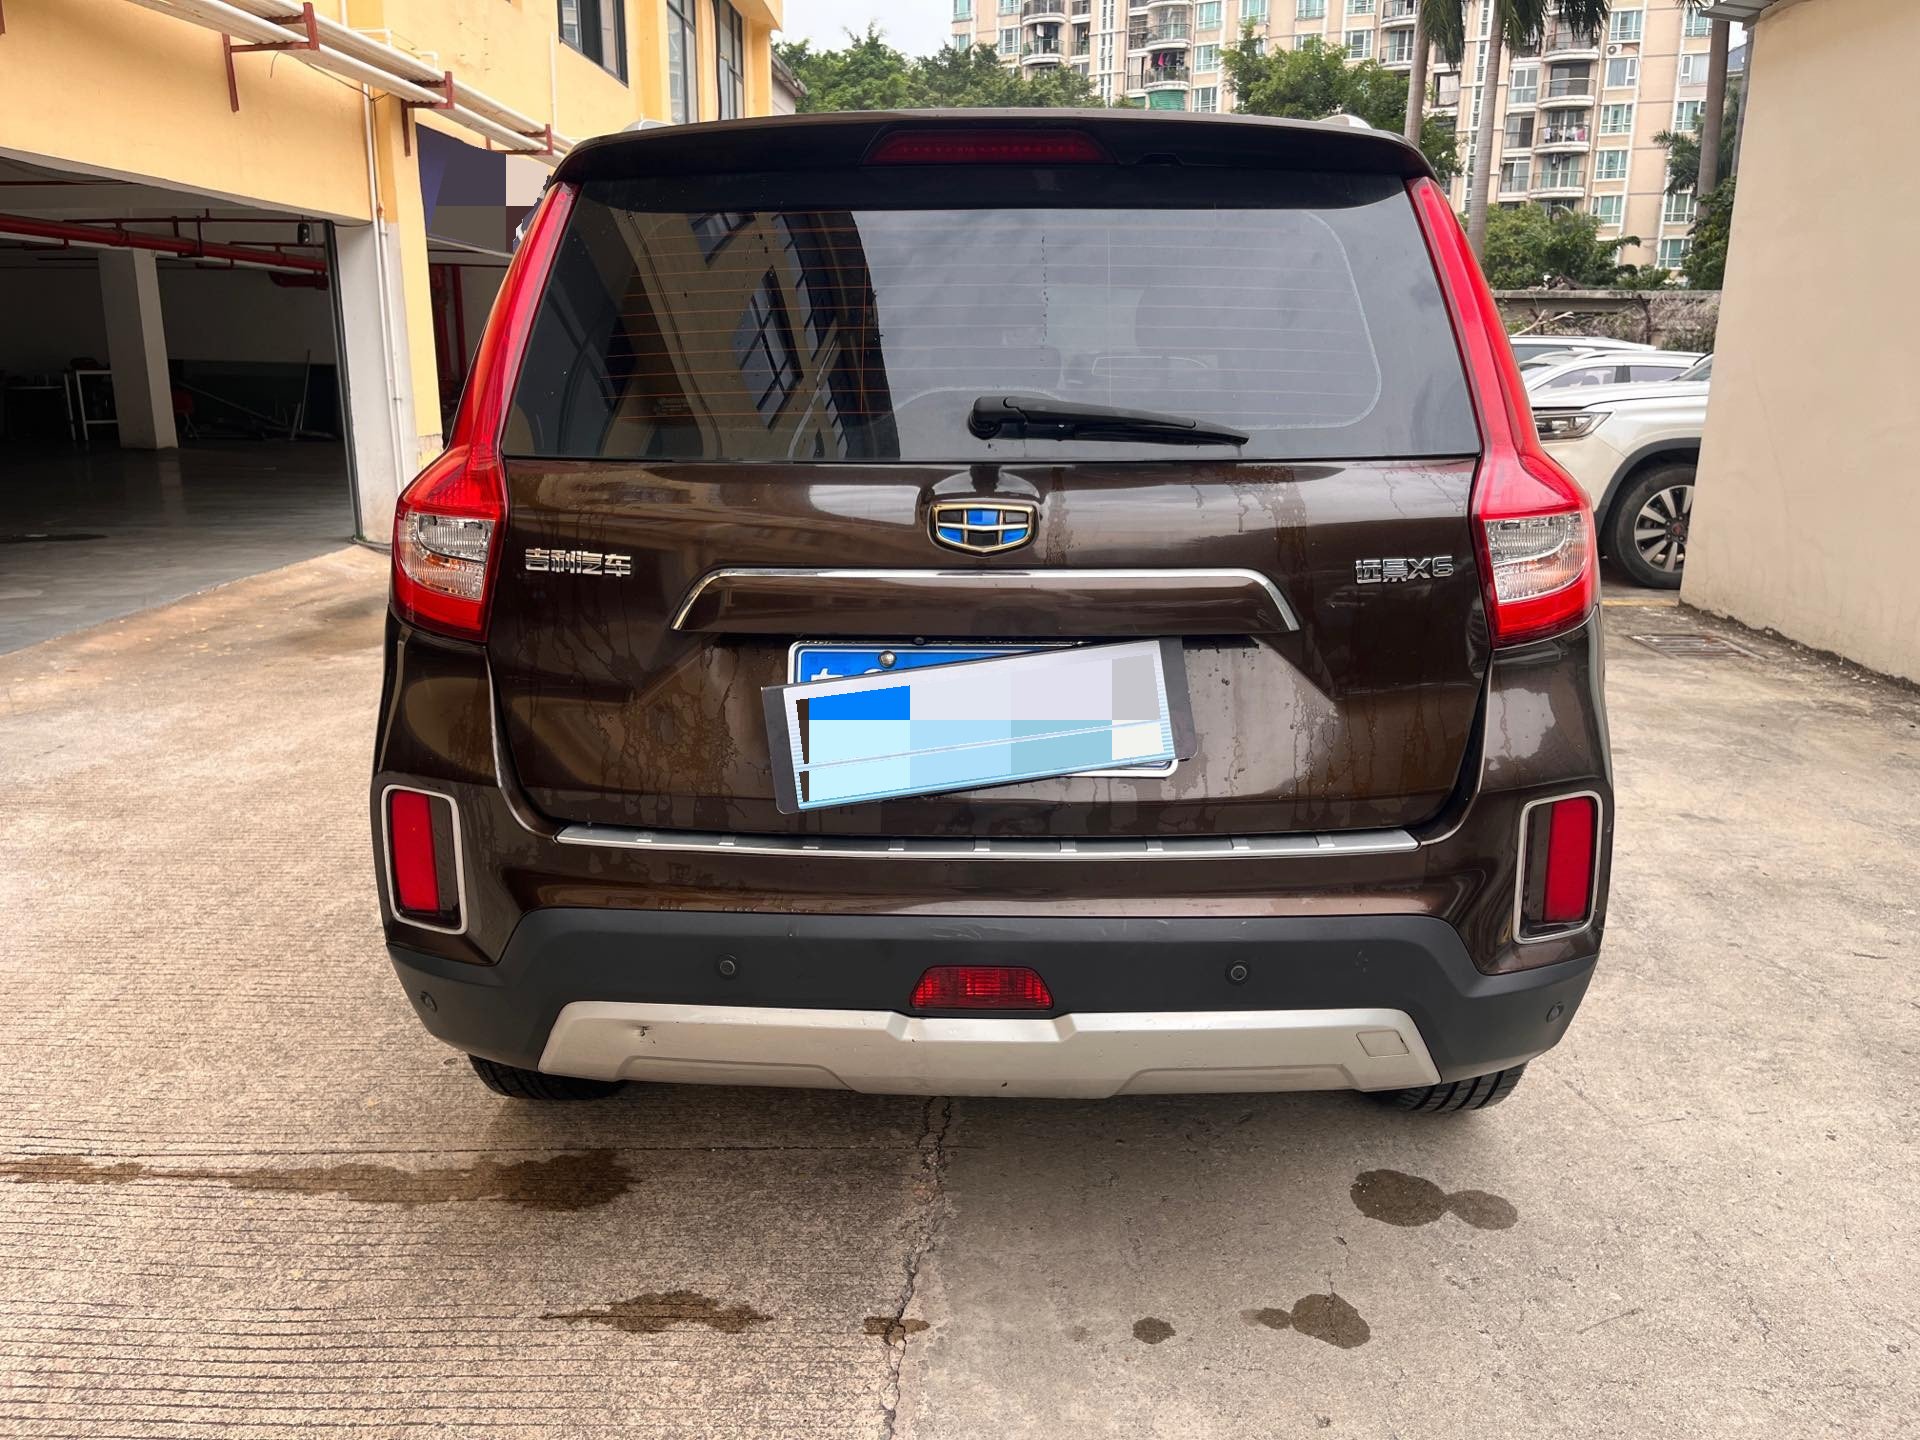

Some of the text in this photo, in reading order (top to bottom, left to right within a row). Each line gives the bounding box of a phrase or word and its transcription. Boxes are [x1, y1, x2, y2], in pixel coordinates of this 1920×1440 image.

[525, 548, 631, 577] 吉利汽车
[1355, 555, 1454, 584] 远景X6
